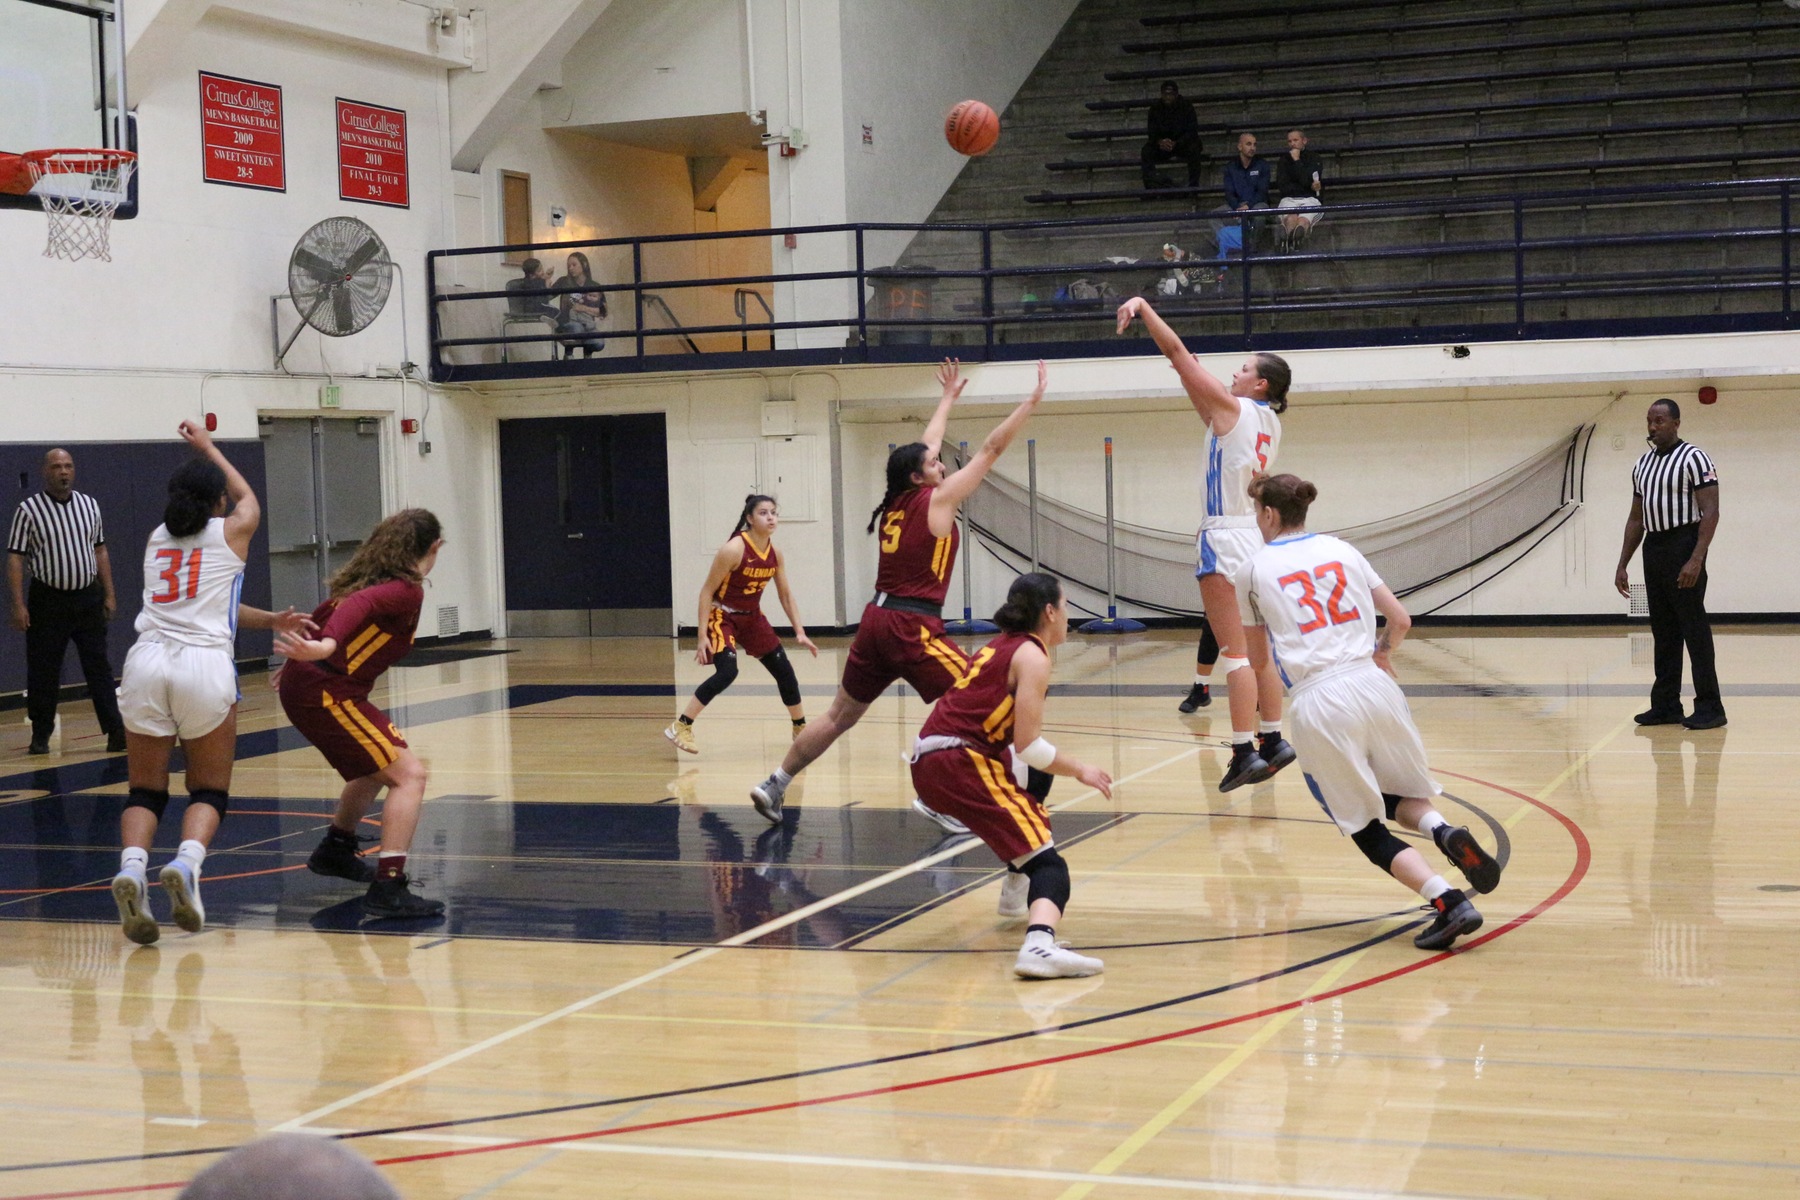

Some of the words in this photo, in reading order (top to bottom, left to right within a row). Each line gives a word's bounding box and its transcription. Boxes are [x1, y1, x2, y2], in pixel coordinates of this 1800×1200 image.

[205, 108, 230, 121] MEN'S
[231, 112, 279, 129] BASKETBALL
[234, 131, 254, 145] 2009
[341, 131, 363, 143] MEN'S
[363, 135, 403, 151] BASKETBALL
[214, 149, 240, 162] SWEET
[242, 154, 274, 167] SIXTEEN
[365, 152, 383, 166] 2010
[237, 166, 254, 179] 28-5
[349, 169, 375, 181] FINAL
[377, 173, 399, 186] FOUR
[368, 184, 382, 196] 29-3
[1252, 432, 1271, 479] 5
[881, 509, 905, 553] 5
[151, 547, 203, 604] 31
[1277, 560, 1361, 635] 32
